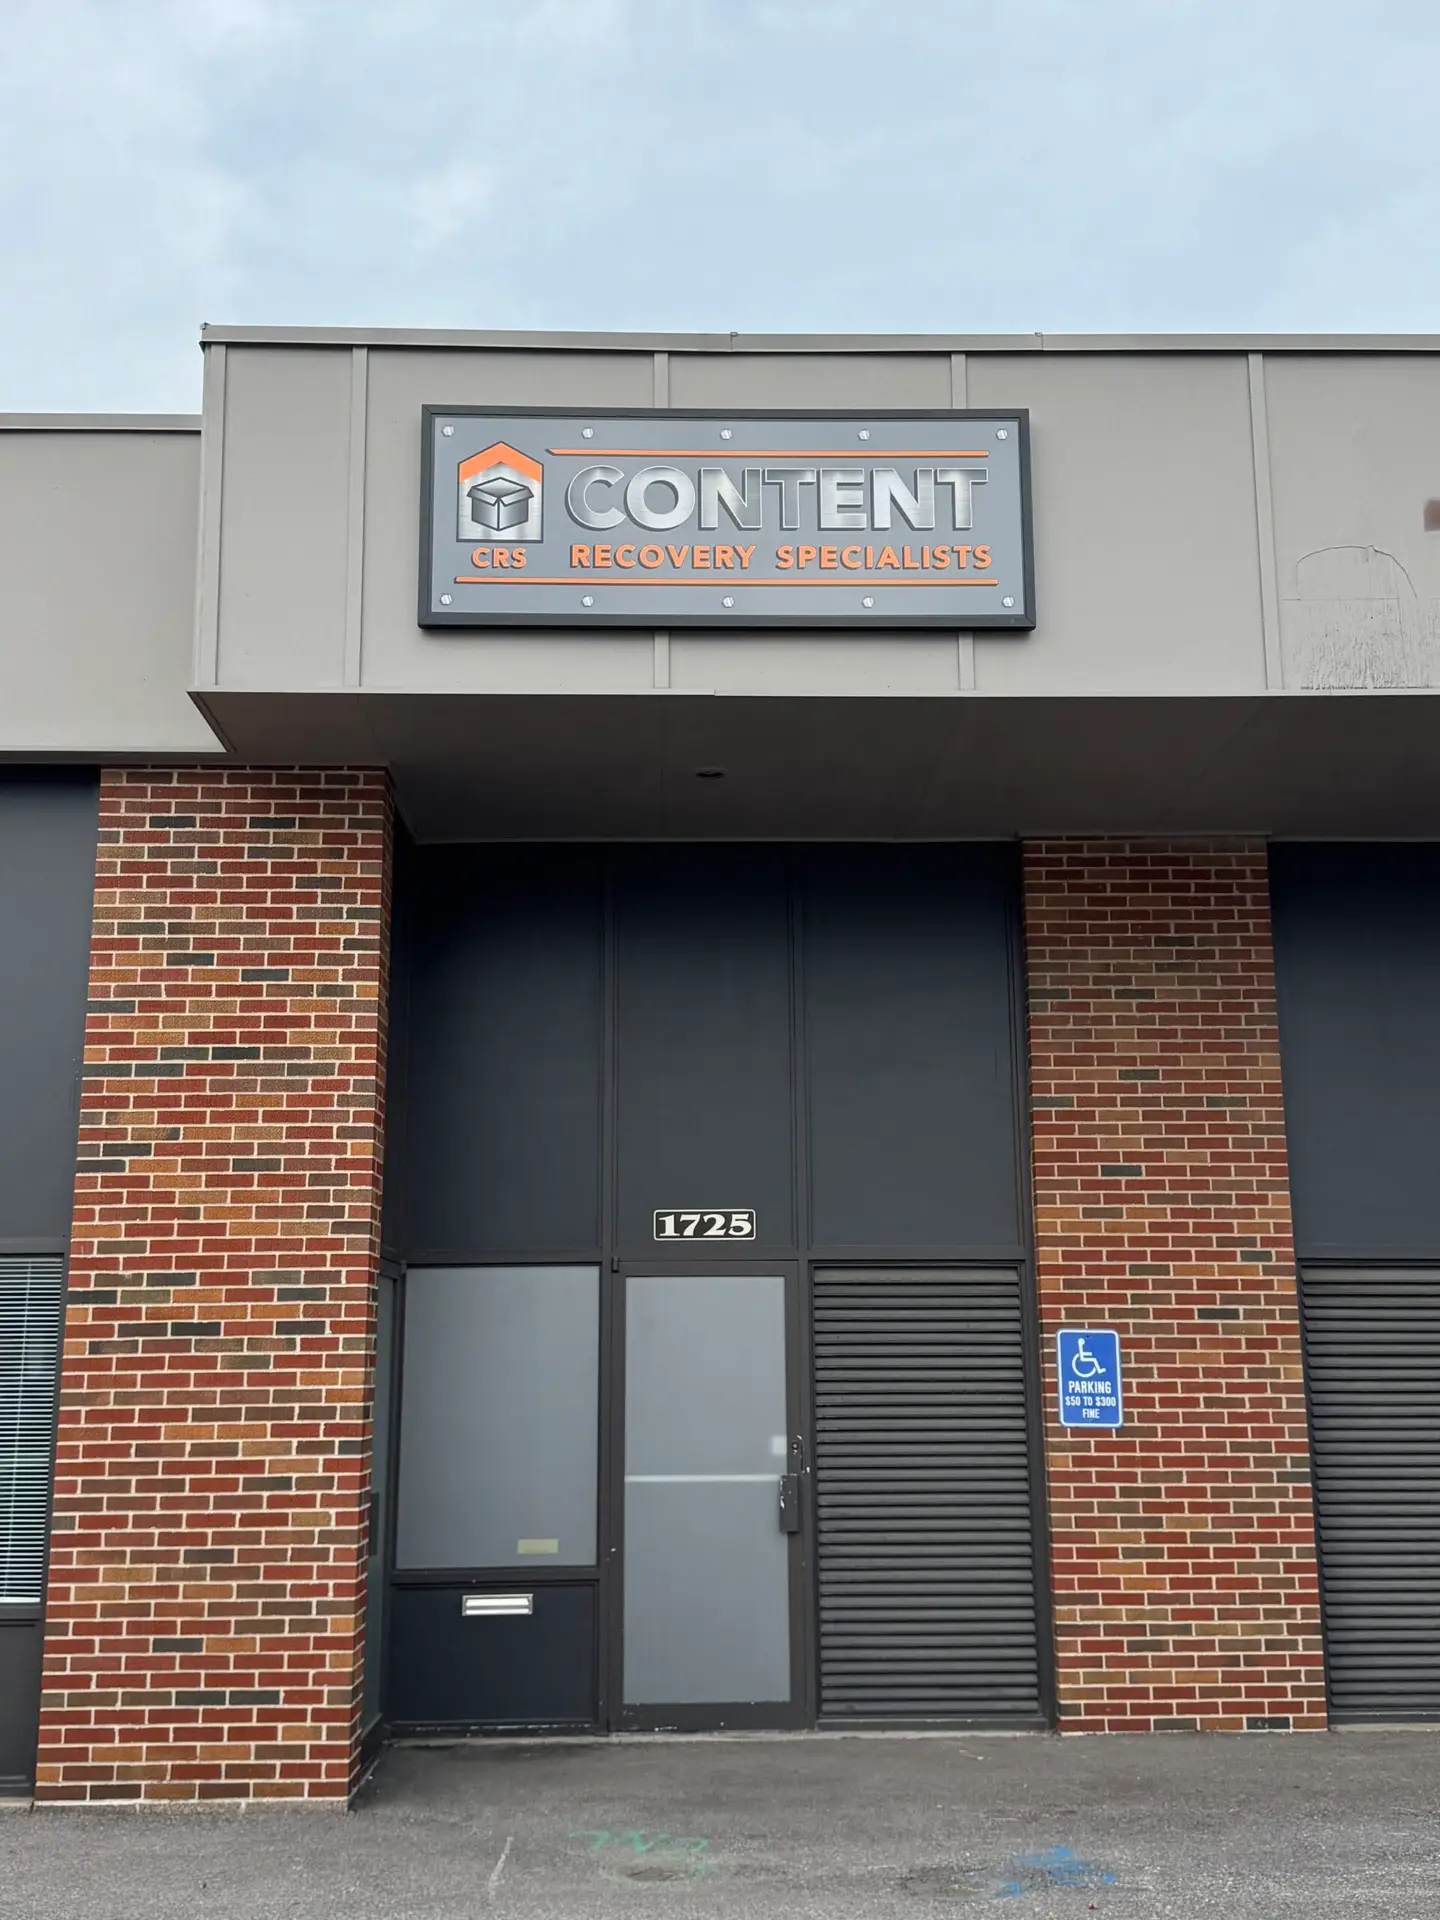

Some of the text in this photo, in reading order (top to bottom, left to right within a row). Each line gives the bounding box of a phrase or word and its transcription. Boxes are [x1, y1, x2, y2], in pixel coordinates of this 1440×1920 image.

[566, 465, 989, 531] CONTENT
[471, 547, 527, 570] CRS
[569, 544, 992, 570] RECOVERY SPECIALISTS
[658, 1213, 752, 1236] 1725
[1068, 1380, 1112, 1394] PARKING
[1065, 1396, 1116, 1407] $50 TO $300
[1082, 1408, 1100, 1419] FINE
